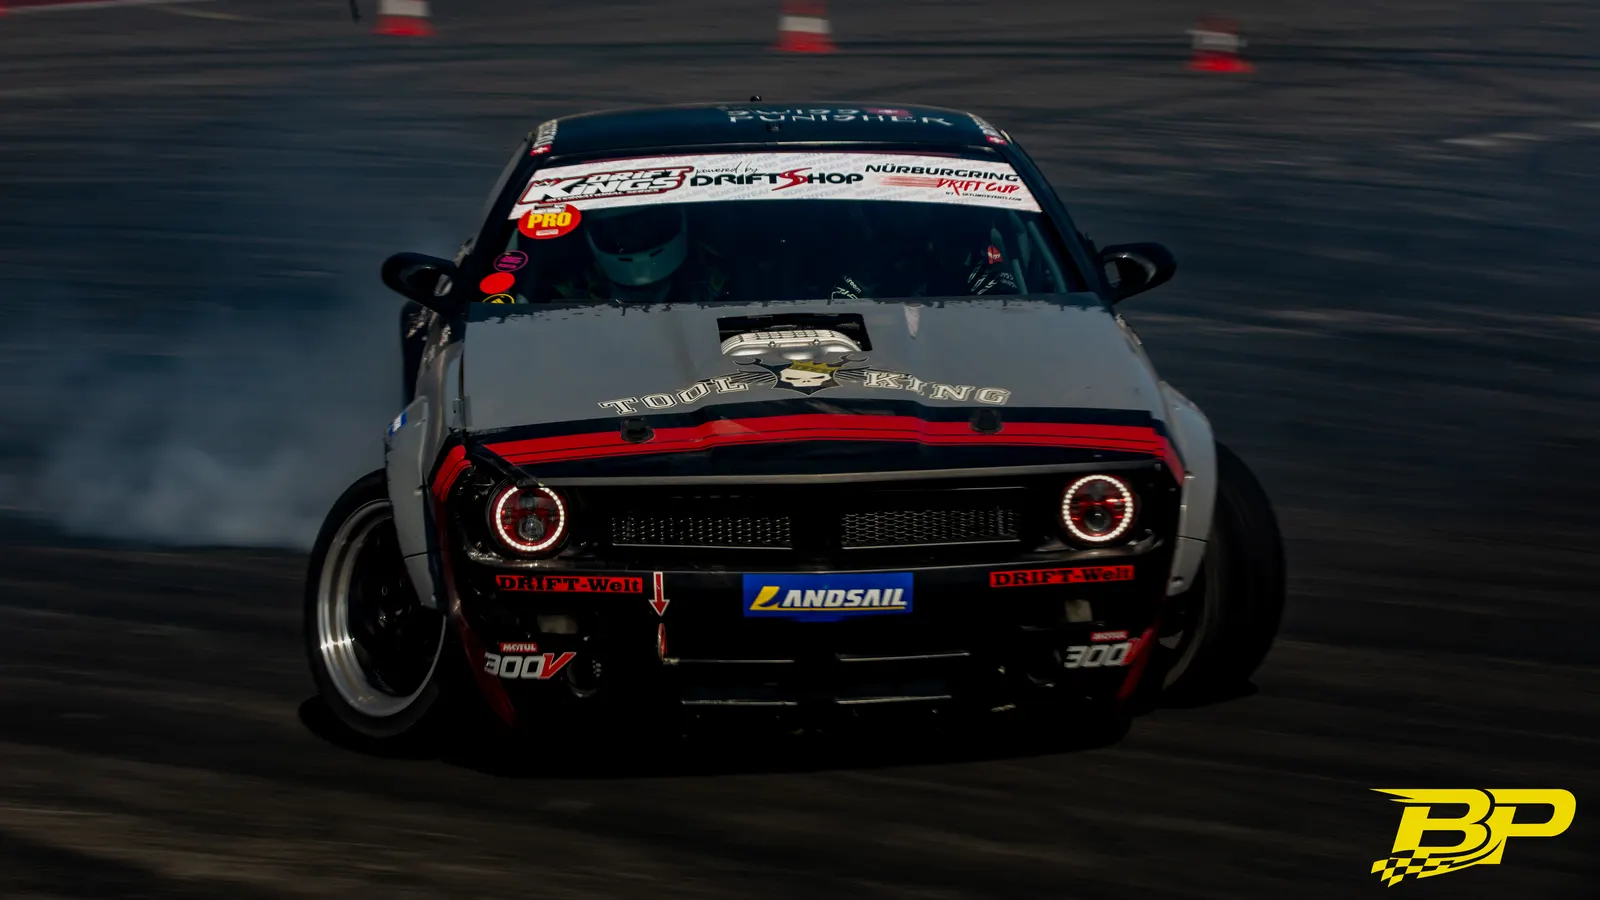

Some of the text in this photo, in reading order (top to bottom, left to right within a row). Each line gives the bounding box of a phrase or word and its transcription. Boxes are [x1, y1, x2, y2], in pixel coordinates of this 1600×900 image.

[729, 114, 954, 126] PUNISHER
[586, 167, 690, 183] DRIFT
[695, 161, 759, 175] powered by
[865, 163, 1020, 182] NÜRBURGRING
[690, 167, 864, 191] DRIFTSHOP
[936, 177, 985, 196] DRIFT
[985, 182, 1021, 194] CUP
[527, 212, 572, 229] PRO
[598, 369, 1012, 415] TOOL KING
[498, 576, 641, 592] DRIFT-Welt
[995, 567, 1131, 586] DRIFT-Welt
[749, 586, 908, 610] LANDSAIL
[502, 643, 536, 651] MOTUL
[484, 652, 577, 679] 300V
